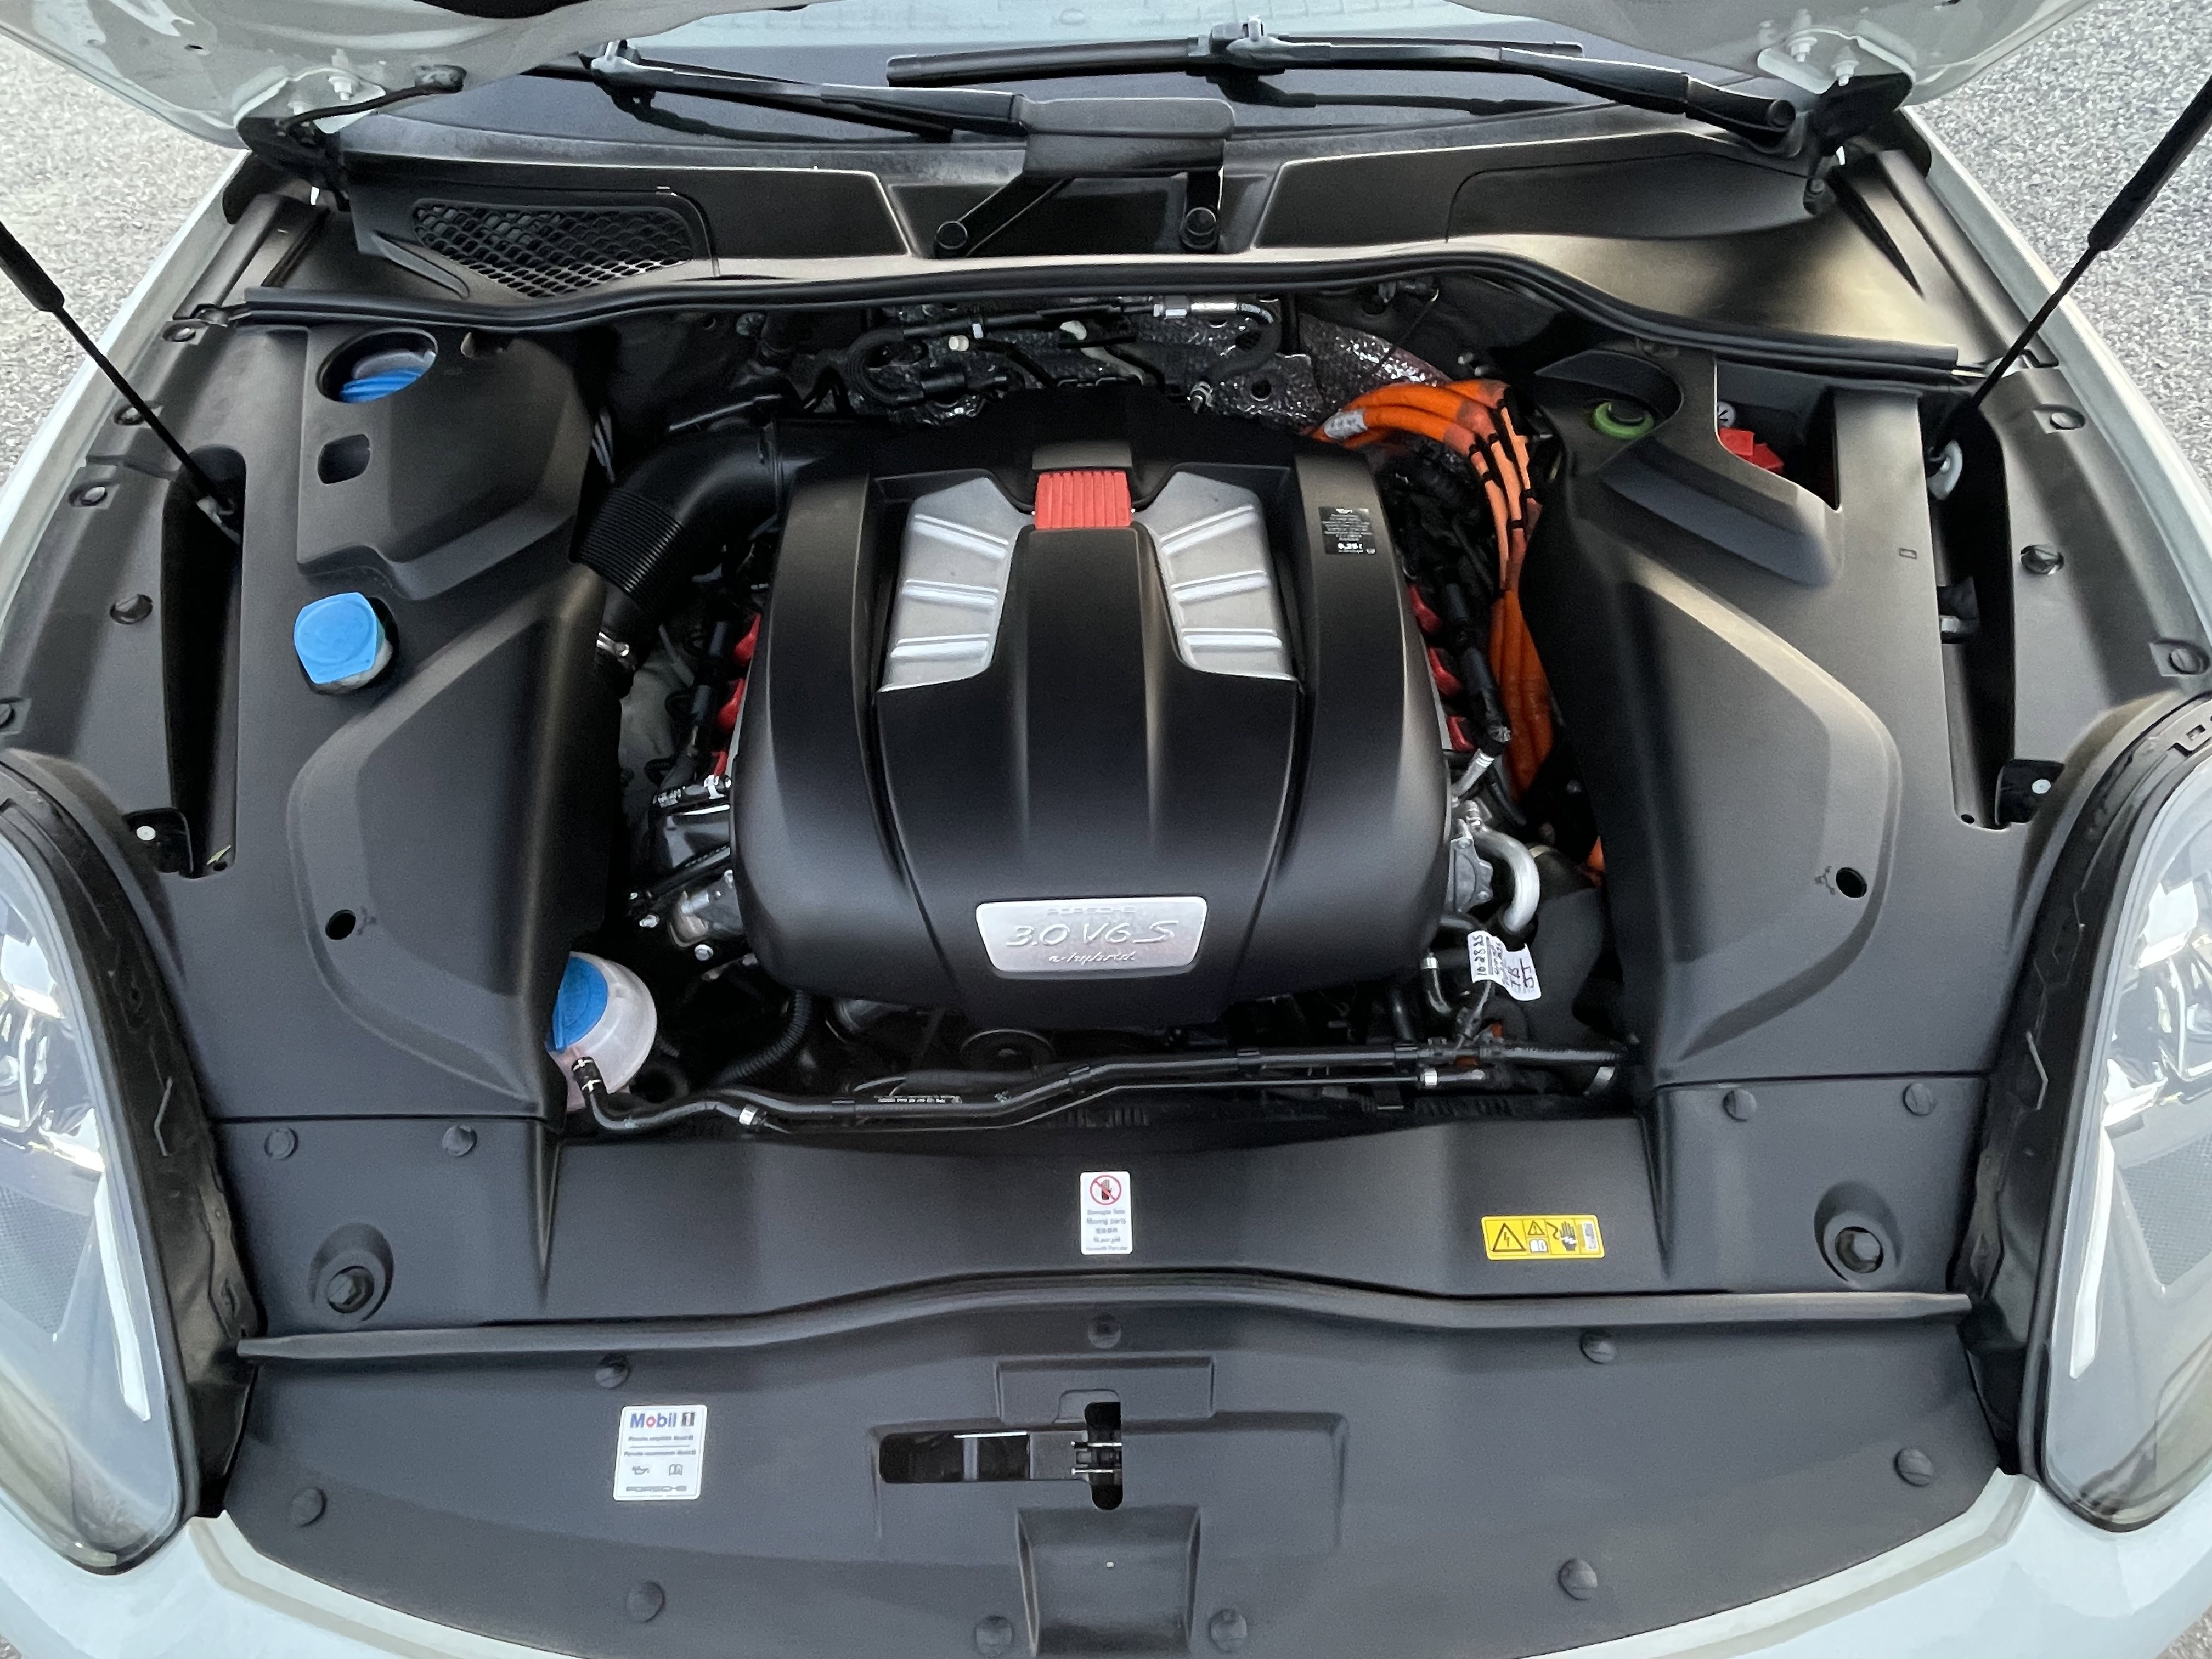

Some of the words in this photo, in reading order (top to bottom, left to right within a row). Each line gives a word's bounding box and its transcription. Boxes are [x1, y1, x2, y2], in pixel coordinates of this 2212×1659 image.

[1006, 924, 1071, 947] 3.0
[1083, 922, 1132, 944] V6
[1132, 919, 1179, 944] S
[630, 1412, 678, 1429] Mobil
